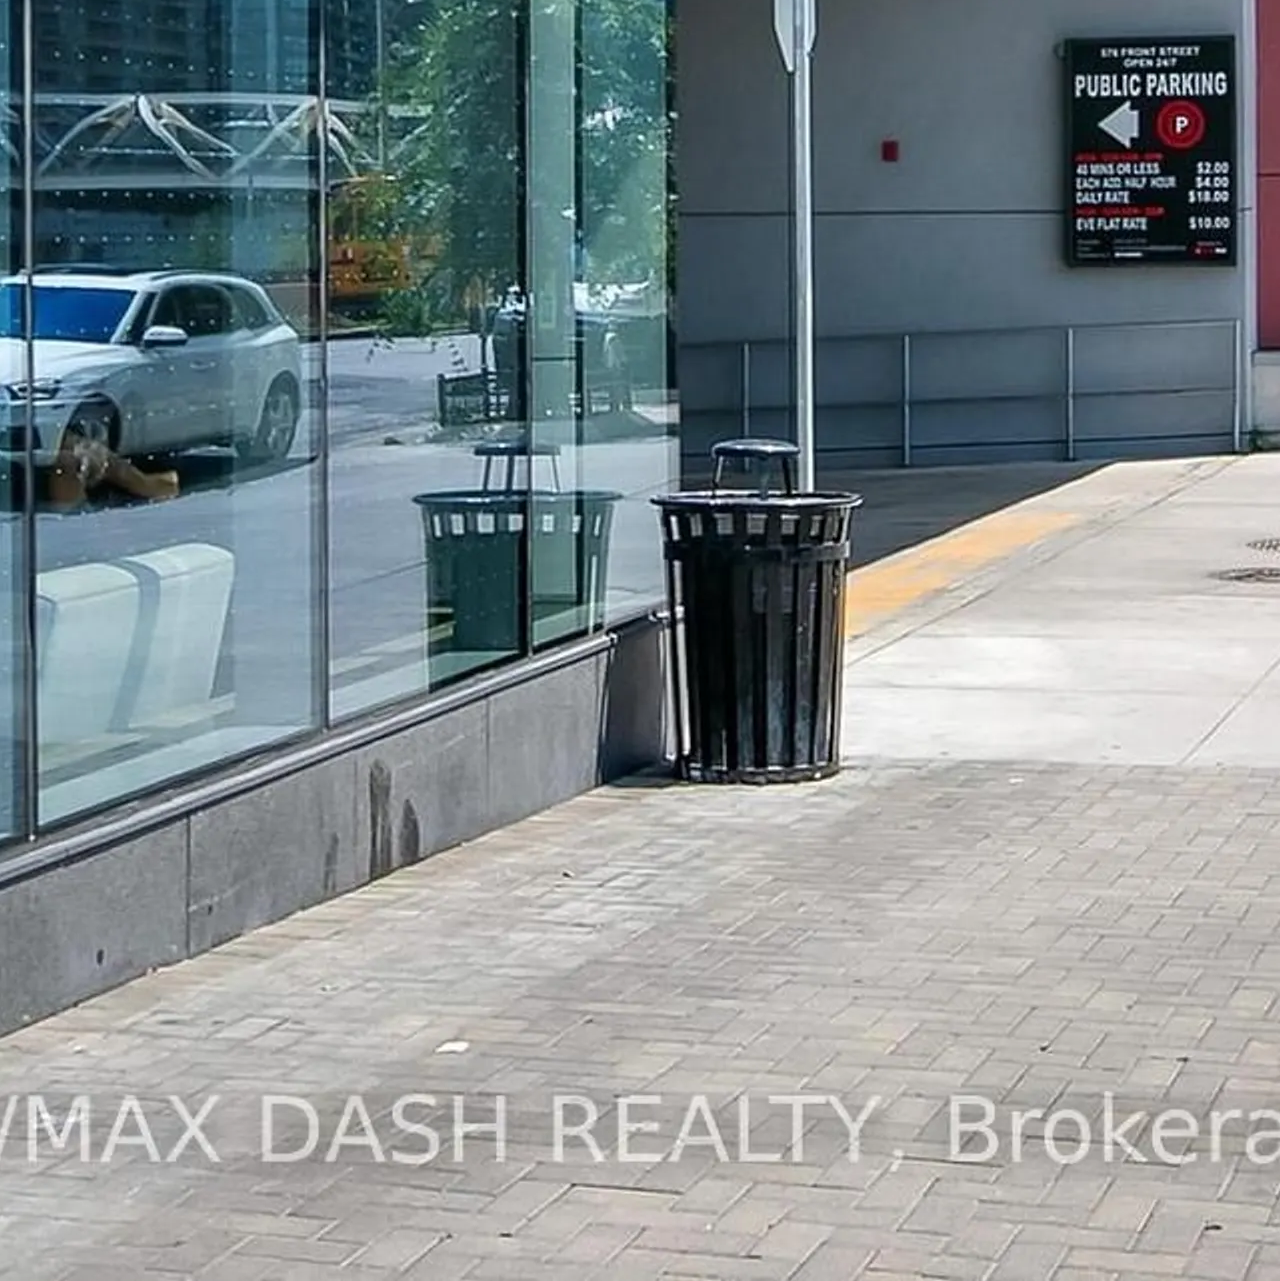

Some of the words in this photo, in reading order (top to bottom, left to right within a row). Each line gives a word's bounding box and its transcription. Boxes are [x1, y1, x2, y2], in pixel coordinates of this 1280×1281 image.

[1121, 46, 1155, 57] FRONT
[1159, 45, 1201, 56] STREET
[1123, 58, 1153, 68] OPEN
[1074, 73, 1141, 98] PUBLIC
[1146, 71, 1228, 97] PARKING
[1175, 116, 1189, 134] P
[1116, 162, 1132, 175] OR
[1133, 162, 1161, 175] LESS
[1196, 161, 1229, 174] $2.00
[1076, 176, 1100, 190] EACH
[1195, 176, 1229, 189] $4.00
[1076, 191, 1103, 204] DAILY
[1104, 191, 1130, 204] RATE
[1096, 217, 1121, 231] FLAT
[1122, 217, 1148, 231] RATE
